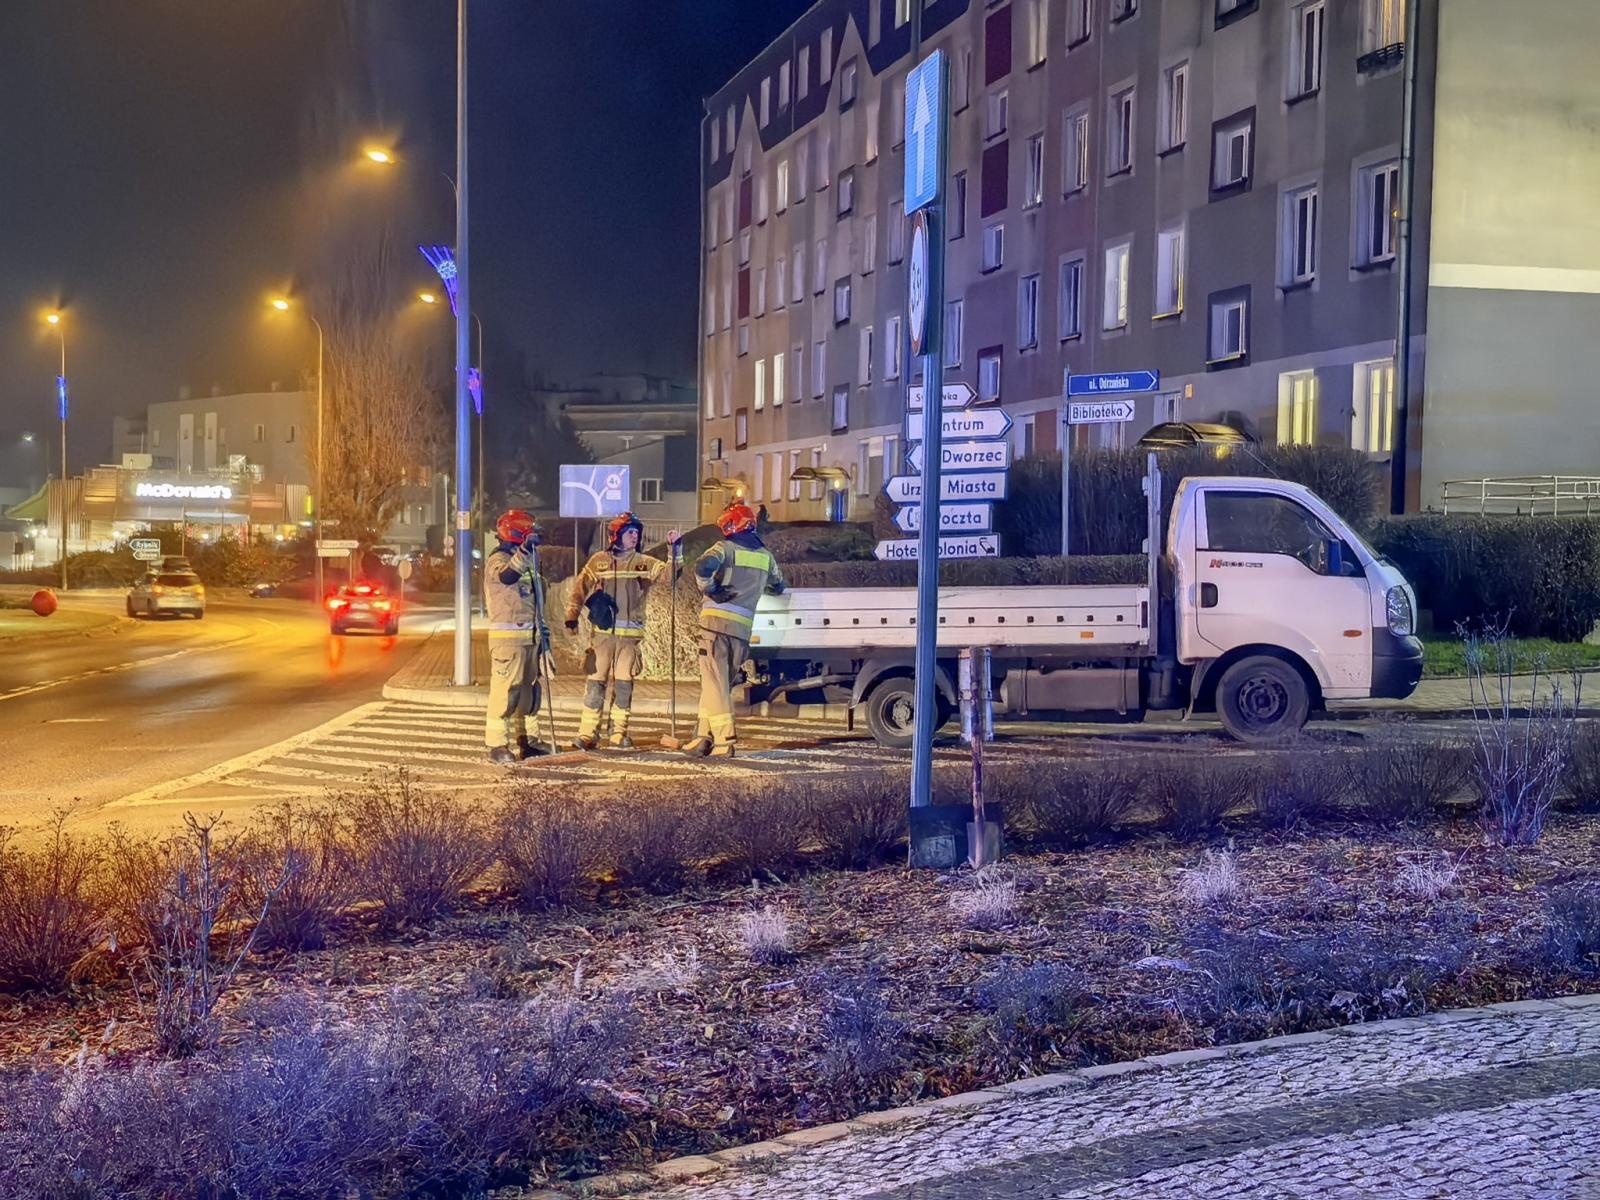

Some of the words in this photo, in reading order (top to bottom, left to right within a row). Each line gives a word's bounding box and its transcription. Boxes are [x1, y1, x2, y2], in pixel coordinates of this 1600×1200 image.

[1088, 378, 1098, 390] ul.
[1072, 405, 1123, 419] Biblioteka
[942, 419, 984, 432] ntrum
[942, 449, 1003, 464] Dworzec
[901, 482, 922, 497] Urz
[947, 479, 996, 494] Miasta
[940, 511, 982, 525] oczta
[938, 540, 978, 556] olonia
